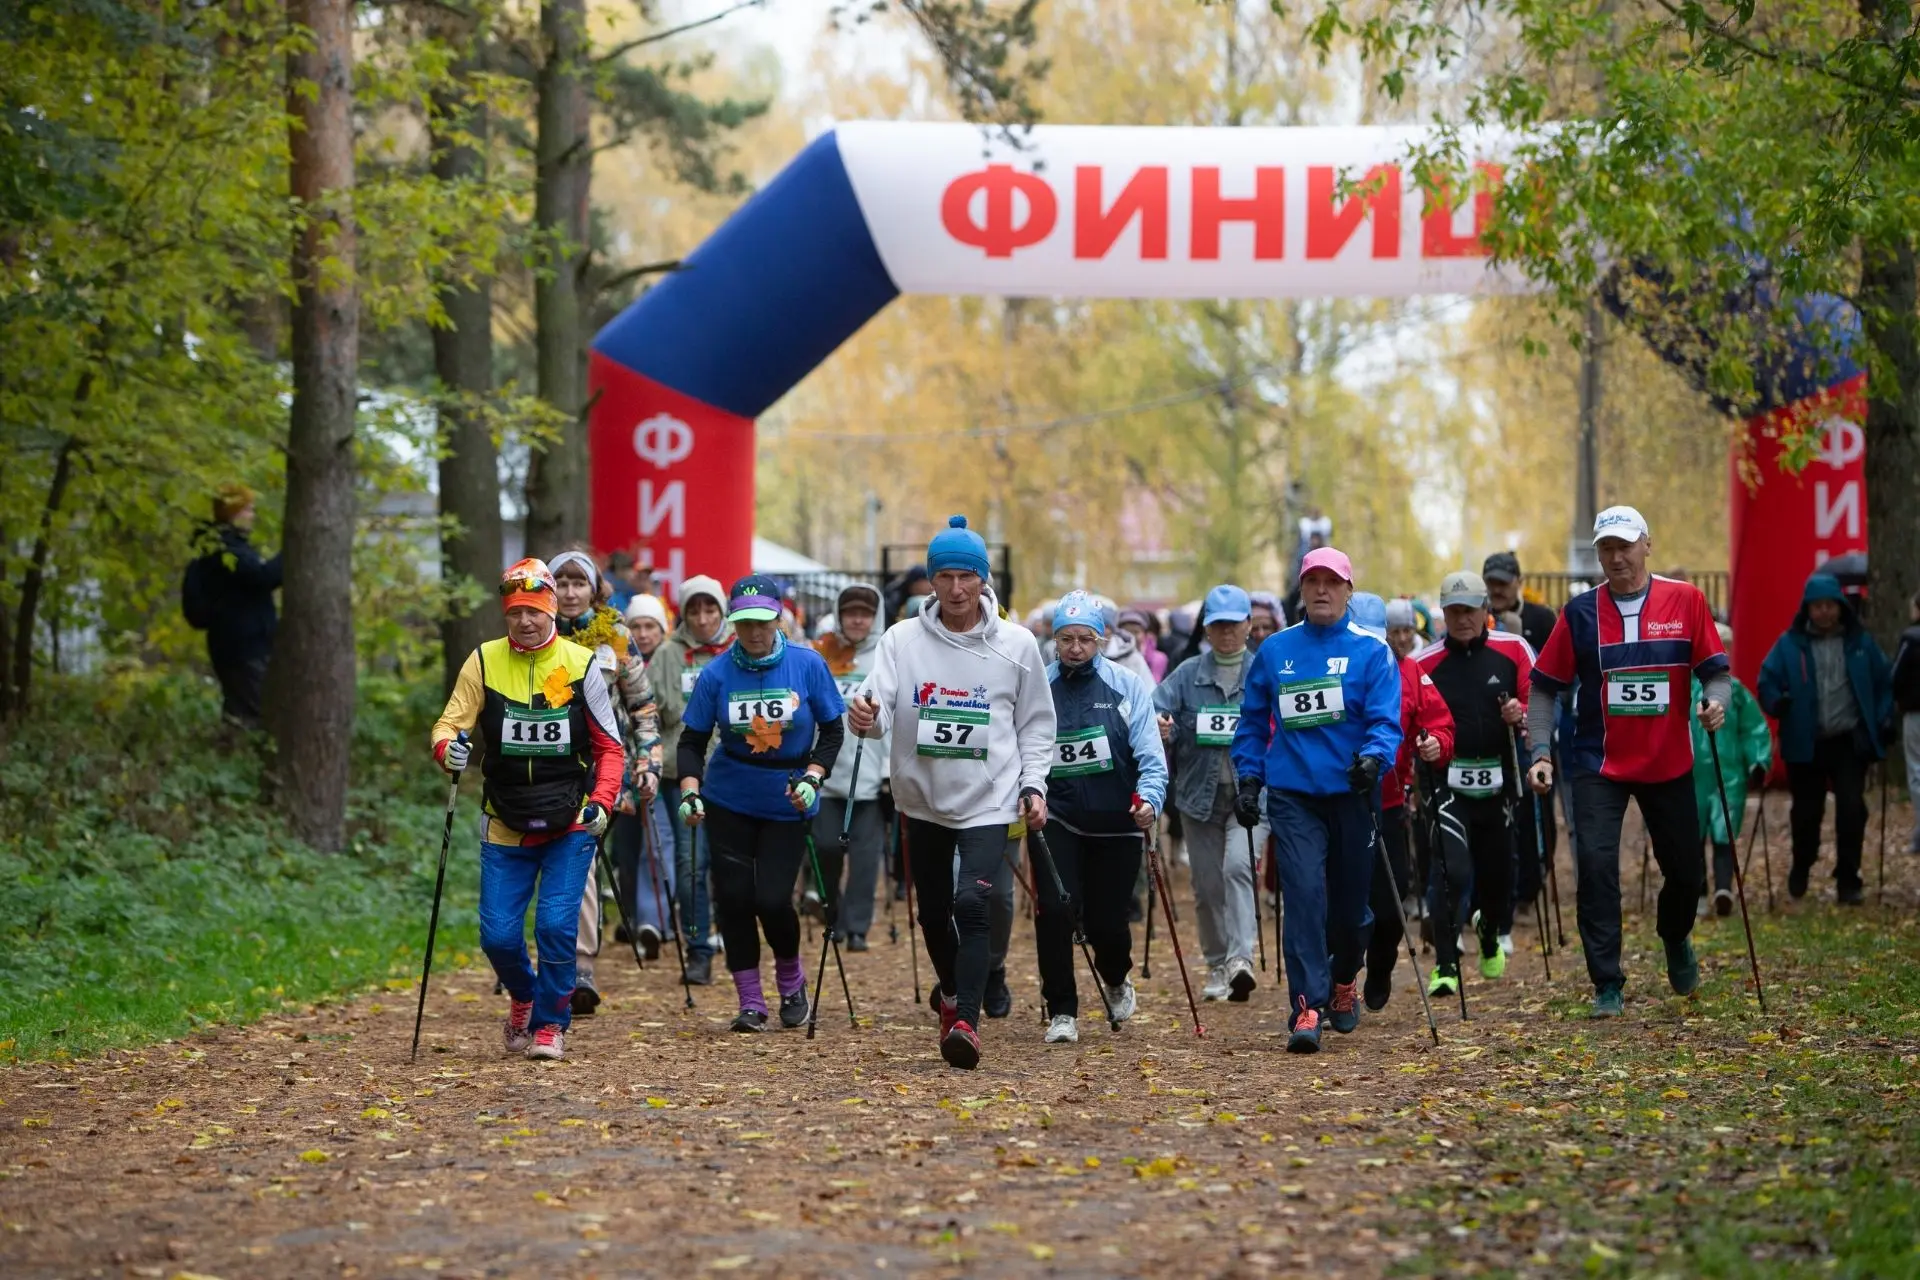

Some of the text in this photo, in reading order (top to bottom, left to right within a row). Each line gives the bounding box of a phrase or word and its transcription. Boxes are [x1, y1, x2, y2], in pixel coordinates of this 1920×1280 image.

[1810, 414, 1865, 570] ФИ
[1294, 691, 1327, 713] 81
[1621, 684, 1656, 701] 55
[738, 700, 784, 720] 116
[947, 699, 990, 710] marathons
[512, 722, 561, 742] 118
[1211, 715, 1240, 731] 87
[934, 723, 974, 745] 57
[1060, 741, 1097, 763] 84
[1460, 770, 1491, 786] 58
